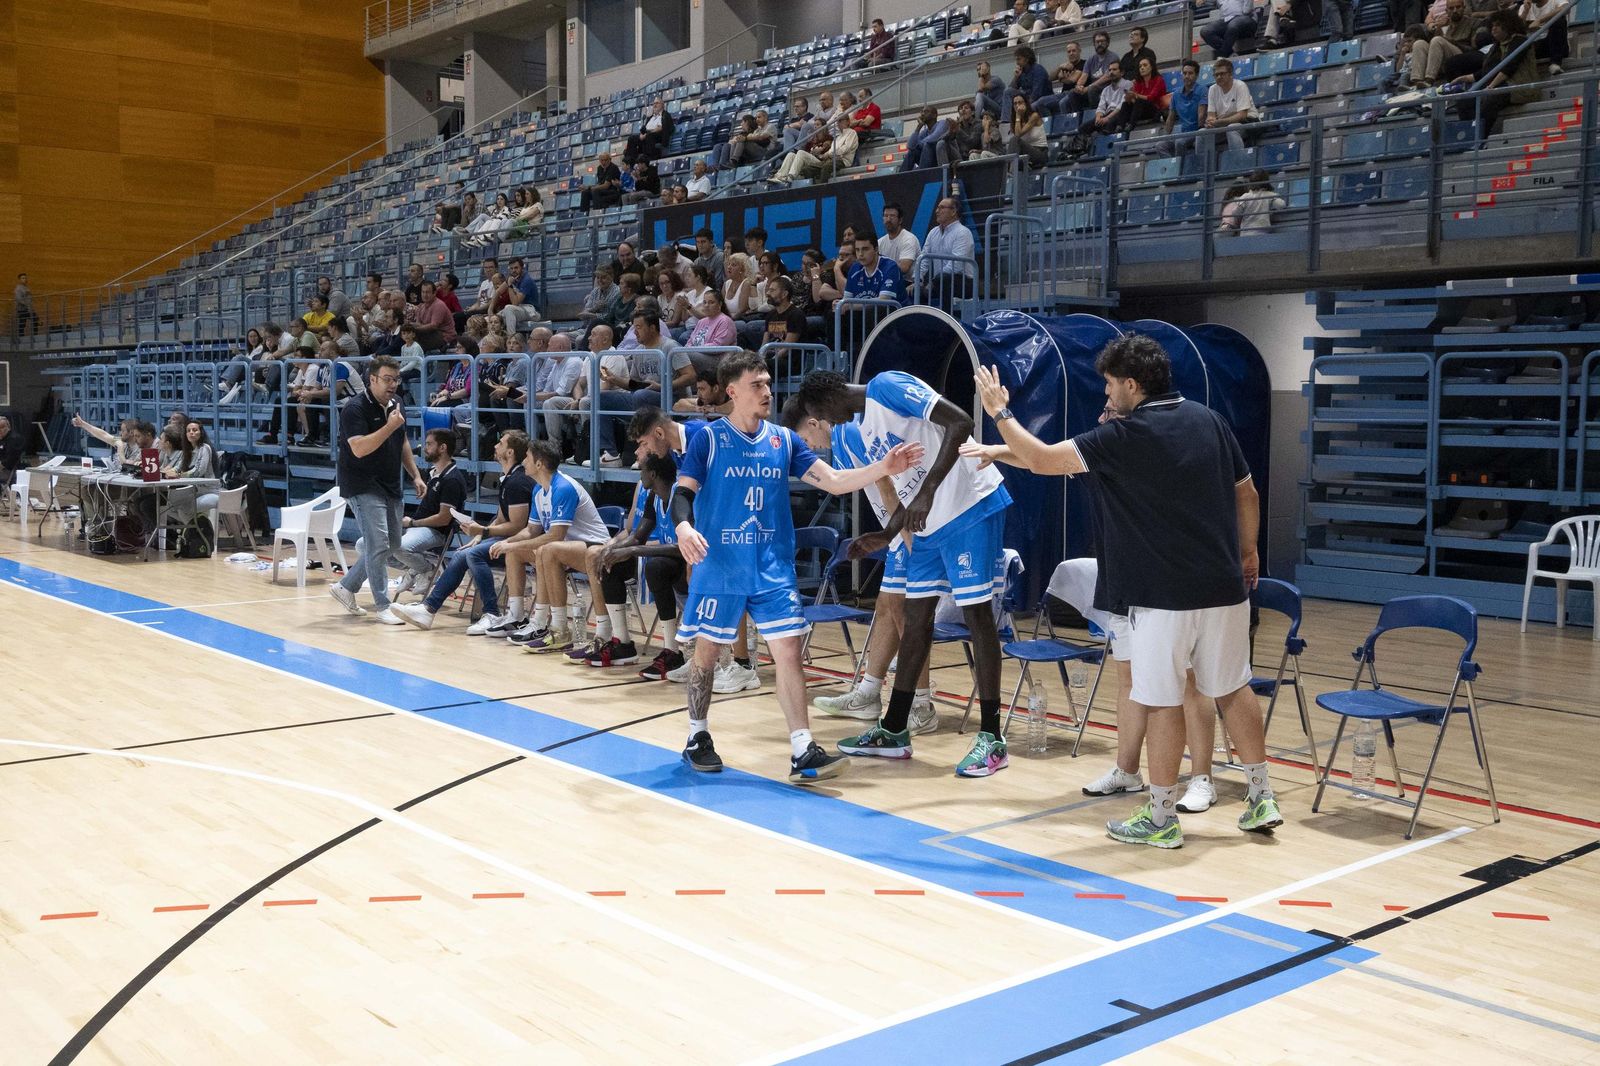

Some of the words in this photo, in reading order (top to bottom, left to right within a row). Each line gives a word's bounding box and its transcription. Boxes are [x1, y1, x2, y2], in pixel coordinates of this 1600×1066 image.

[1533, 176, 1555, 185] FILA
[145, 457, 158, 474] 5
[744, 486, 764, 511] 40
[557, 505, 564, 517] 5
[696, 597, 718, 620] 40
